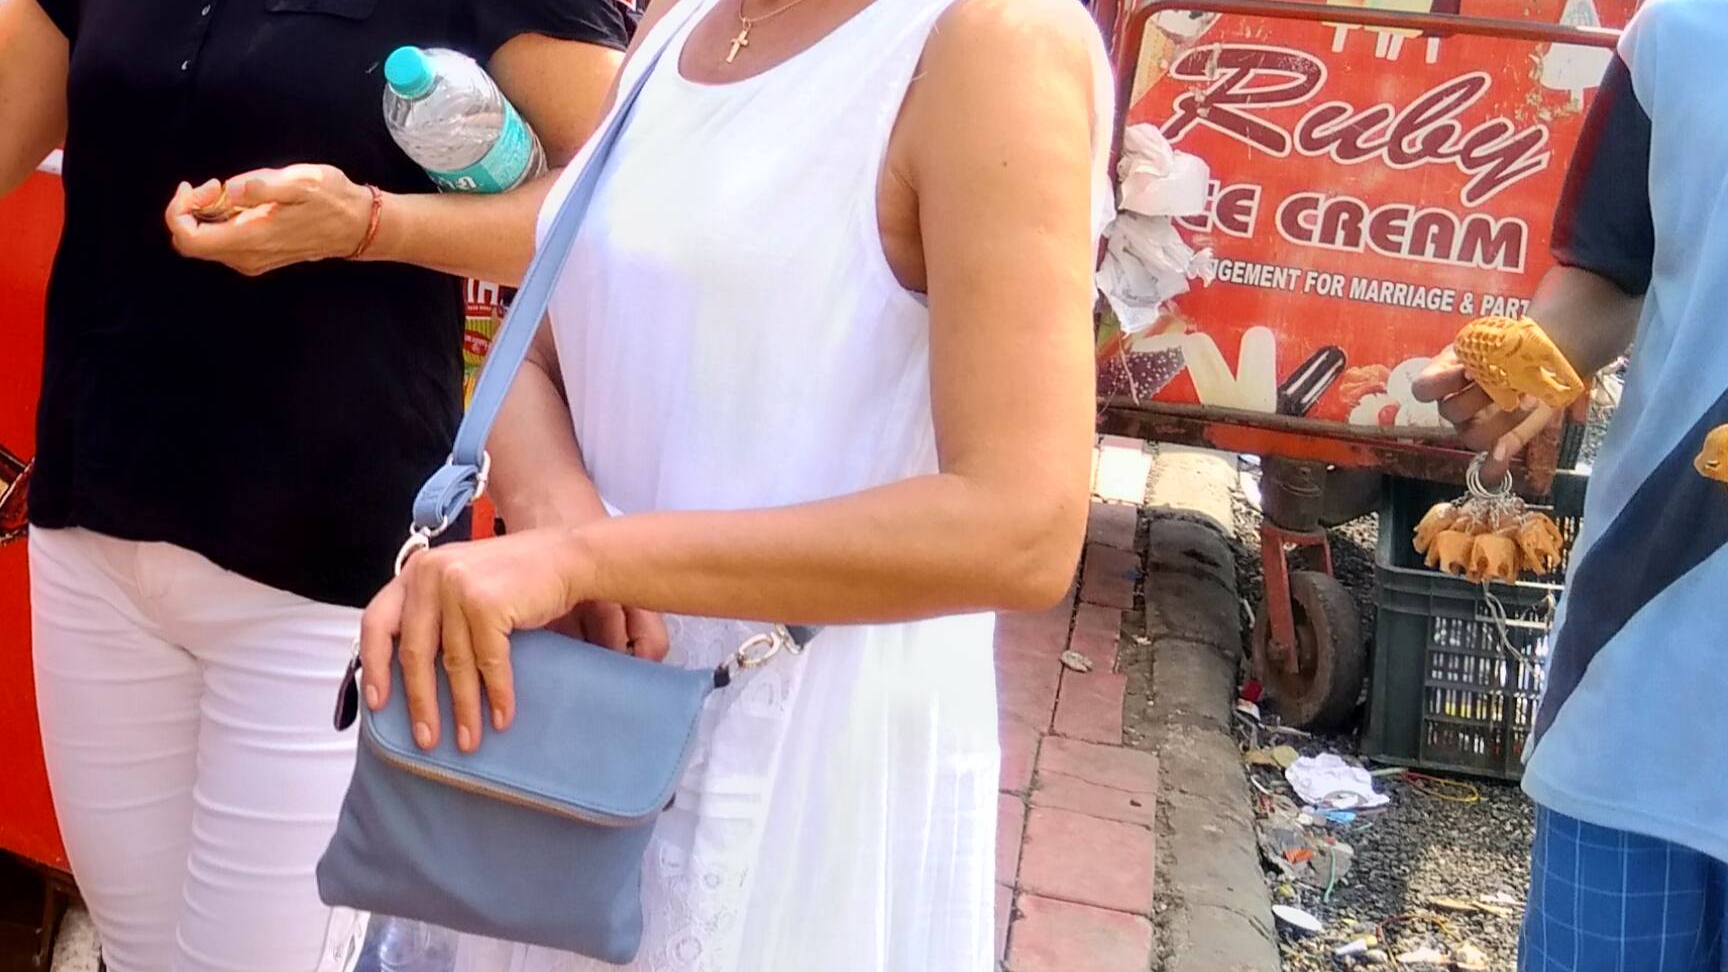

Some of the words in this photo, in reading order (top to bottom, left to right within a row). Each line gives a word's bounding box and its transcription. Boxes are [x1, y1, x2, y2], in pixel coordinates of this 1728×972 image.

[1161, 44, 1553, 208] Ruby
[1275, 192, 1529, 275] CREAM
[1304, 272, 1346, 298] FOR
[1349, 276, 1455, 313] MARRIAGE
[1459, 291, 1475, 315] &
[1479, 293, 1532, 319] PART
